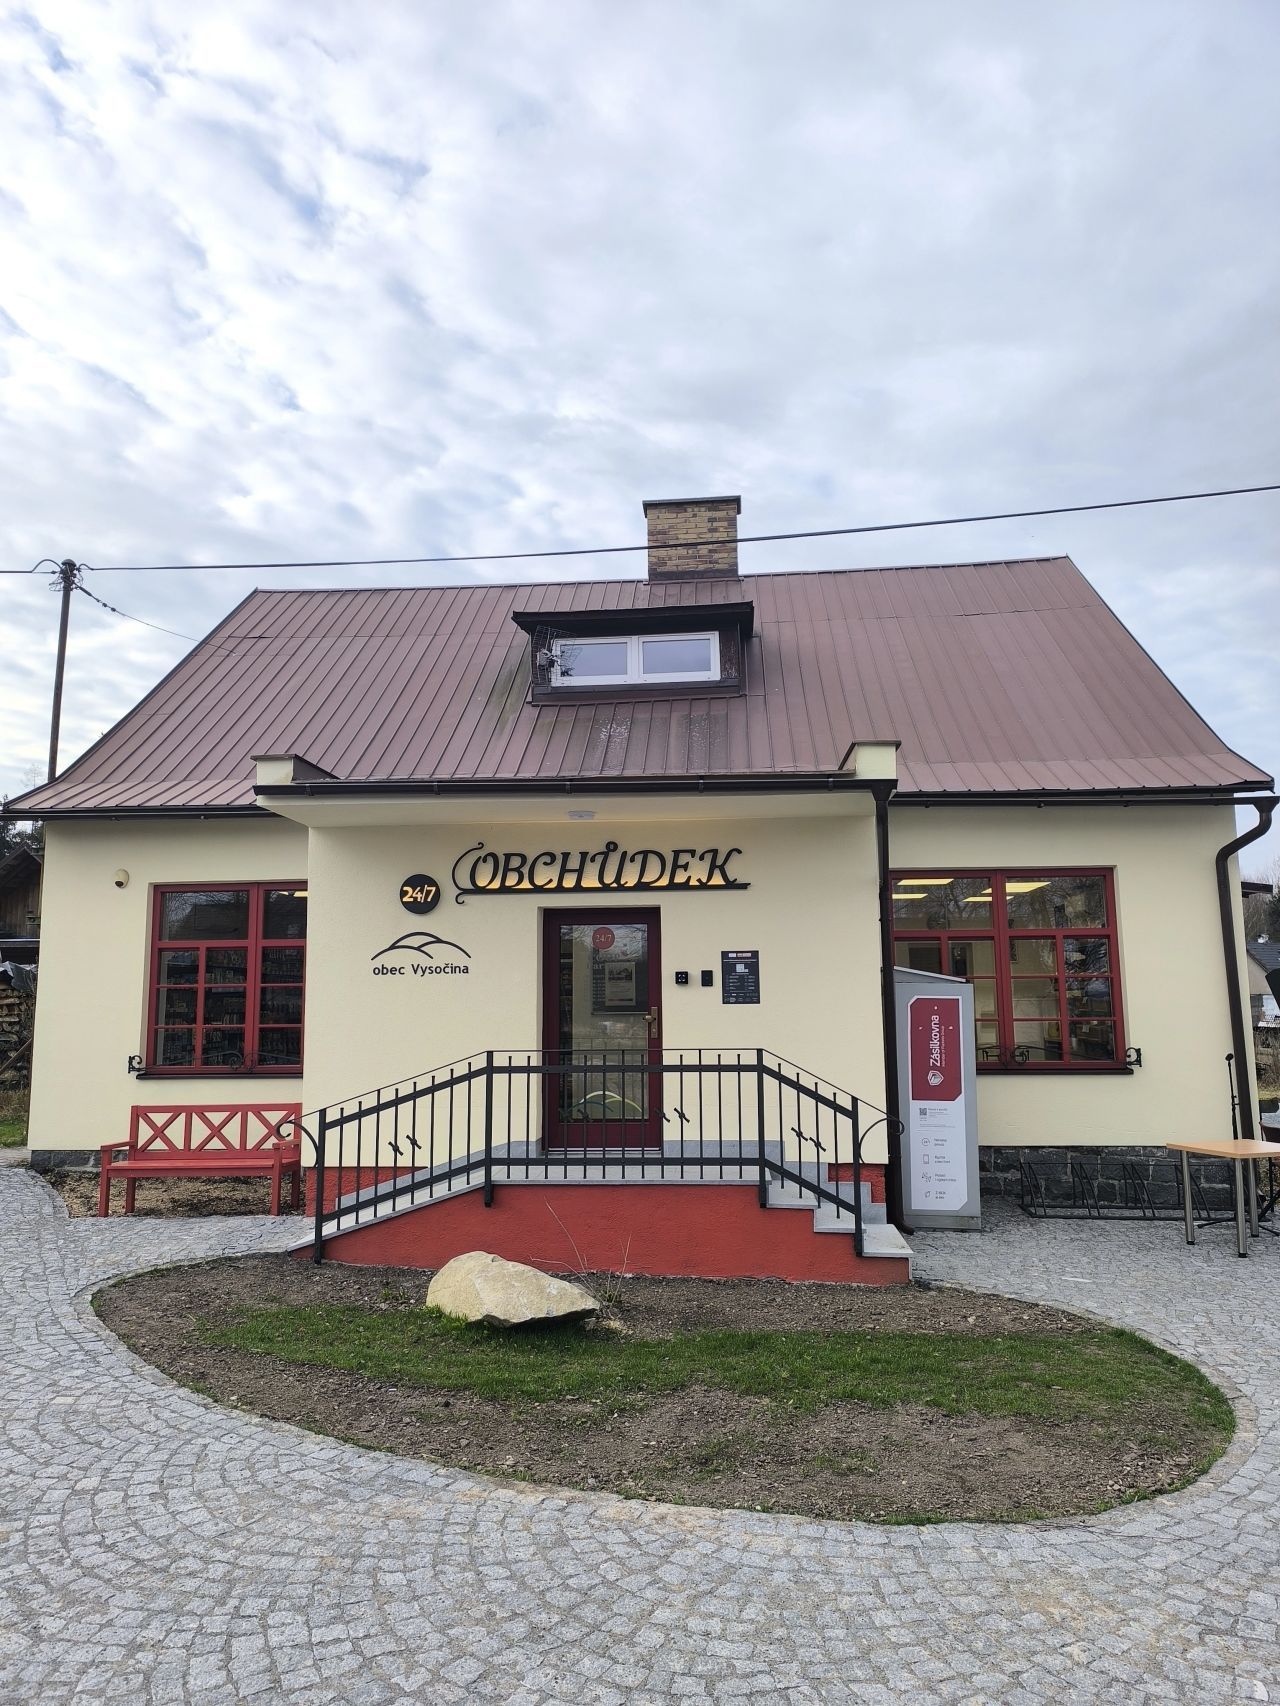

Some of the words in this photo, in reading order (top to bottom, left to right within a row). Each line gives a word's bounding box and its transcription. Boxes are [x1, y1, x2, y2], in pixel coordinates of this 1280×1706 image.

[467, 841, 744, 891] OBCHŮDEK
[402, 884, 437, 903] 24/7
[595, 933, 613, 943] 24/7
[372, 964, 406, 976] obec
[411, 963, 470, 977] Vysočina
[929, 1015, 941, 1067] Zásilkovna
